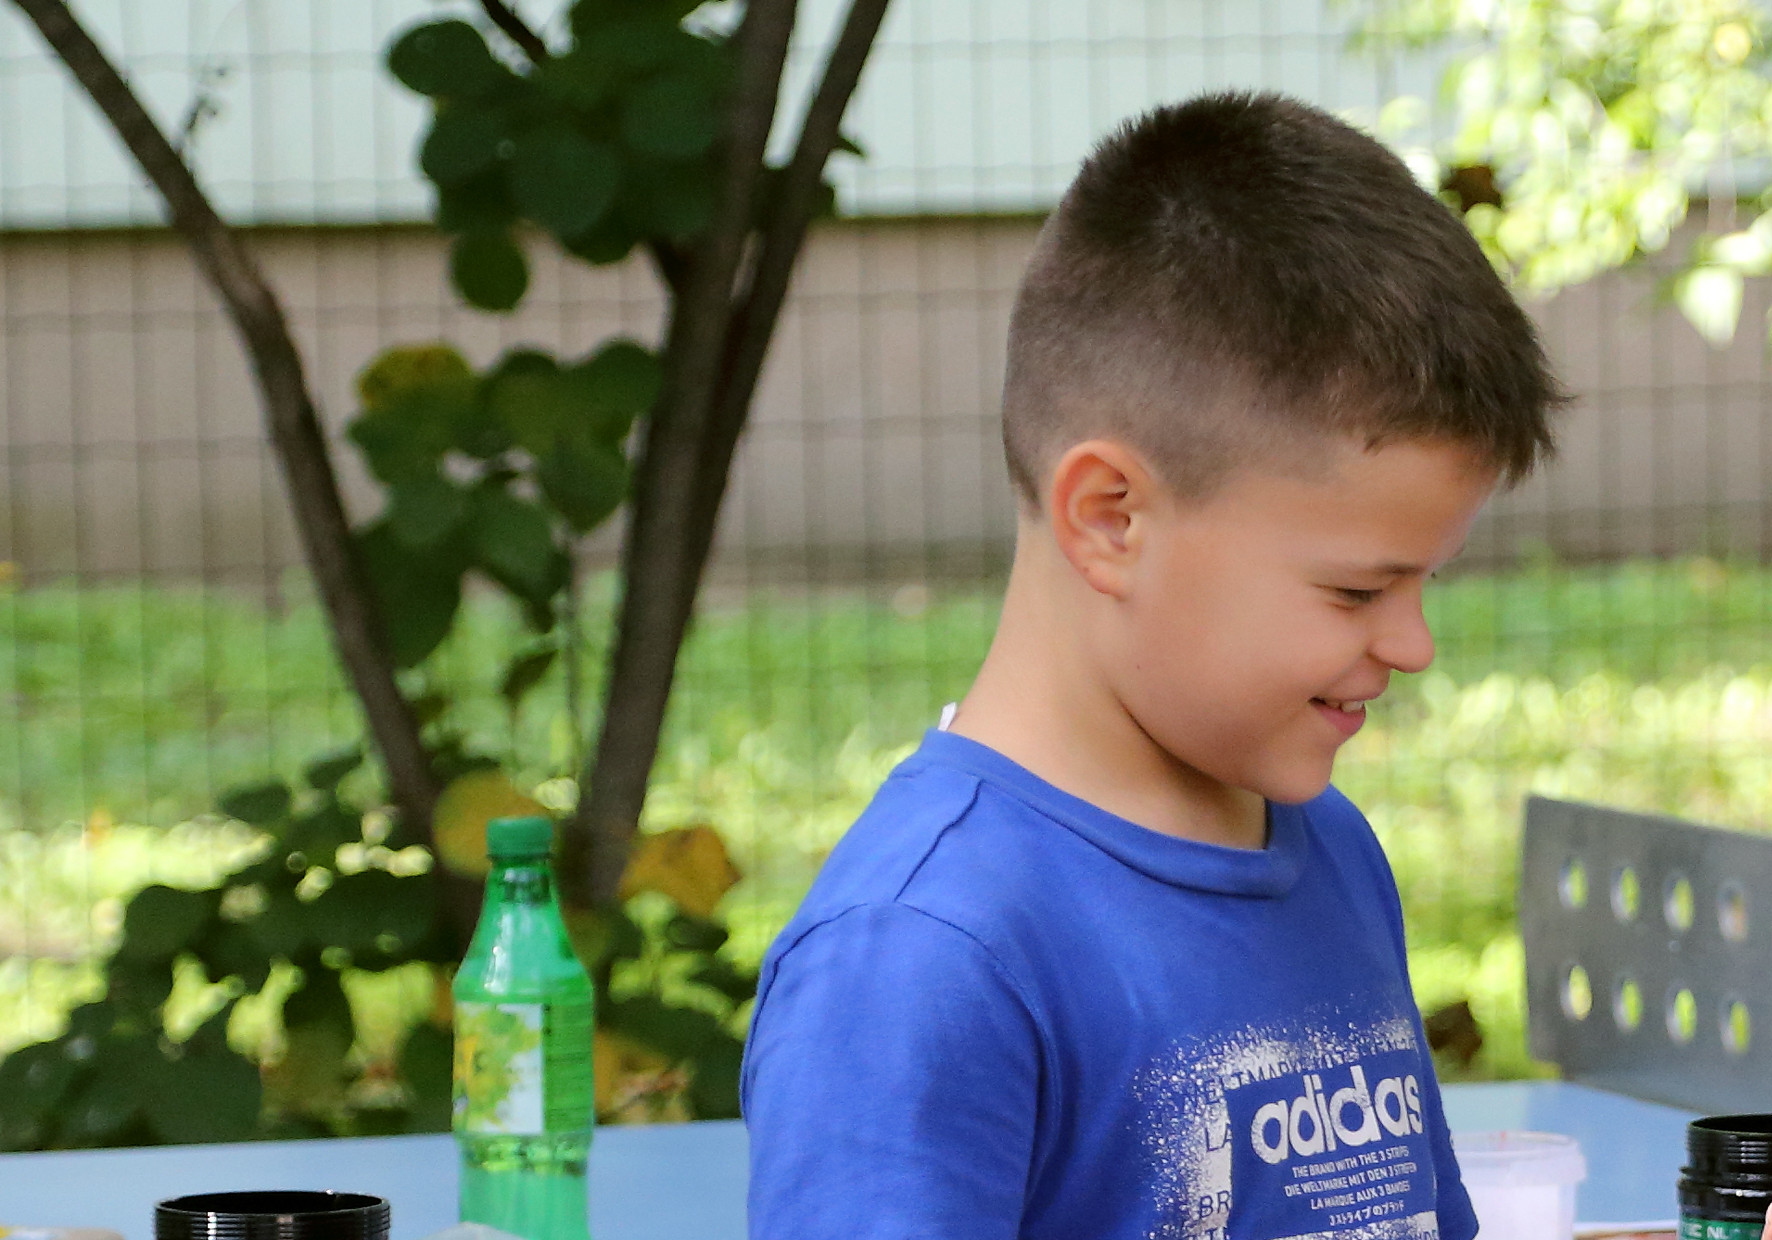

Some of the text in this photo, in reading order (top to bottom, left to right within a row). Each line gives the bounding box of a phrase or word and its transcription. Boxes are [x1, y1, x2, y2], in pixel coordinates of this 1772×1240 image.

[1251, 1065, 1423, 1164] adidas
[1292, 1165, 1308, 1178] THE
[1309, 1161, 1336, 1176] BRAND
[1336, 1157, 1358, 1172] WITH
[1358, 1153, 1378, 1165] THE
[1378, 1150, 1386, 1161] 3
[1284, 1185, 1302, 1197] DIE
[1301, 1176, 1349, 1194] WELTMARKE
[1348, 1173, 1366, 1186] MIT
[1368, 1168, 1387, 1182] DEN
[1311, 1198, 1324, 1210] LA
[1324, 1193, 1356, 1208] MARQUE
[1356, 1188, 1378, 1202] AUX
[1377, 1186, 1385, 1197] 3
